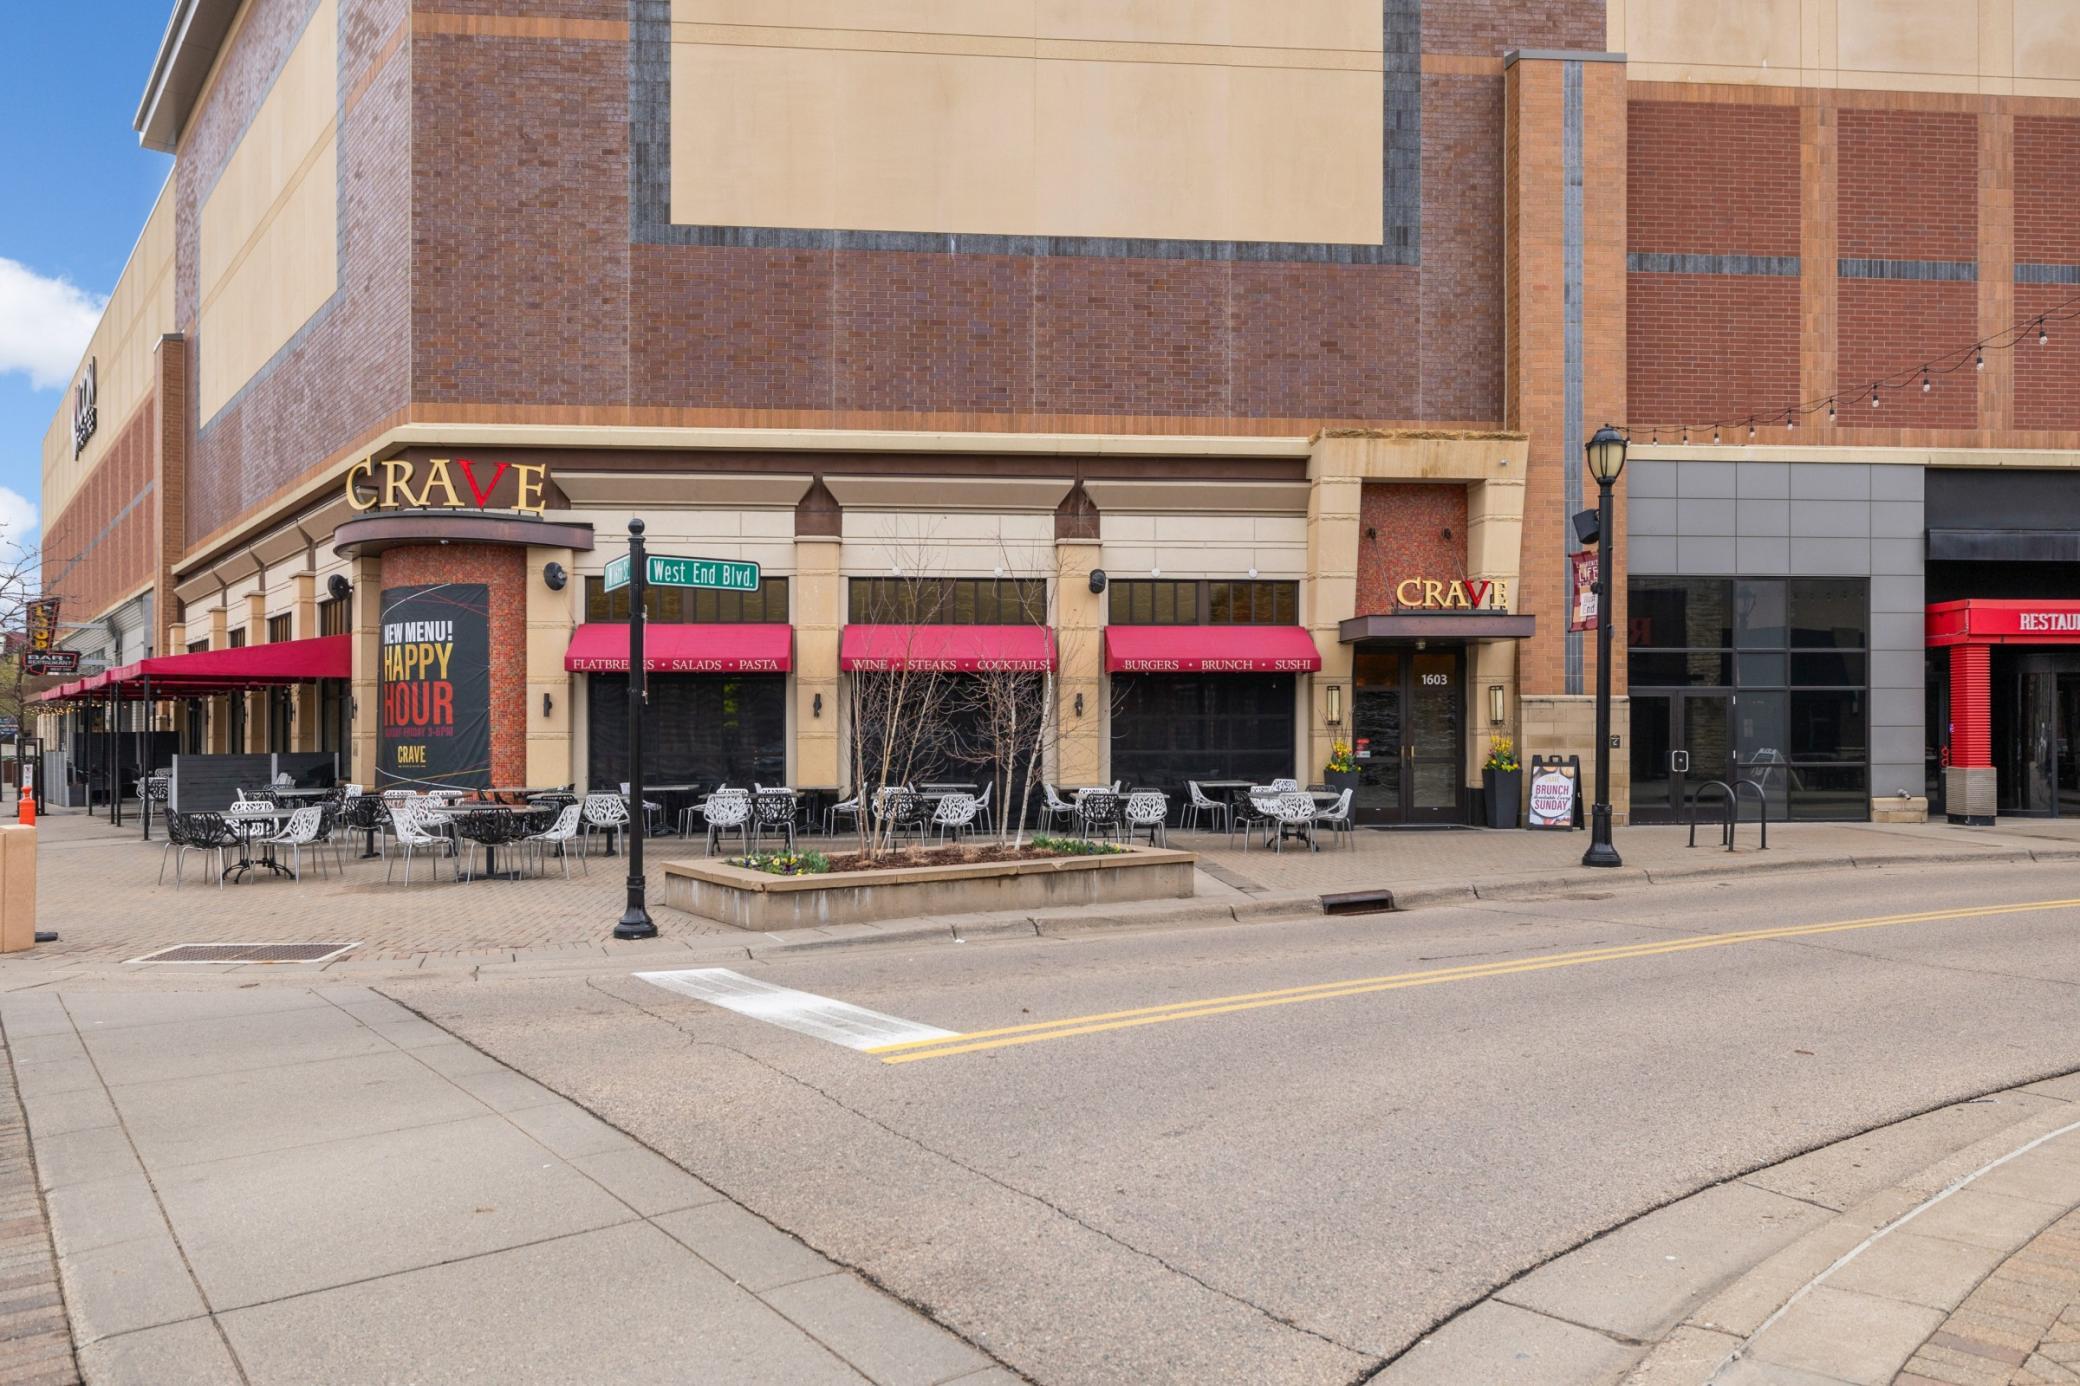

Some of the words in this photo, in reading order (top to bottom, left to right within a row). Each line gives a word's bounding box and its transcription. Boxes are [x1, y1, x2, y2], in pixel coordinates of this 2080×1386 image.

[345, 454, 546, 518] CRAVE
[653, 559, 686, 584] West
[693, 562, 716, 585] End
[723, 564, 754, 588] Blvd.
[1396, 576, 1509, 609] CRAVE
[384, 623, 403, 645] NEW
[405, 620, 453, 643] MENU!
[384, 642, 454, 682] HAPPY
[573, 659, 655, 671] FLATBRES
[672, 659, 722, 671] SALADS
[739, 659, 778, 670] PASTA
[852, 659, 888, 670] WINE
[909, 660, 957, 670] STEAKS
[977, 660, 1047, 670] COCKTAILS
[1124, 660, 1179, 670] BURGERS
[1201, 660, 1253, 670] BRUNCH
[1275, 660, 1311, 670] SUSHI
[1421, 674, 1448, 685] 1603
[384, 680, 454, 727] HOUR
[397, 745, 426, 764] CRAVE
[1535, 785, 1569, 796] BRUNCH
[1534, 799, 1568, 811] SUNDAY
